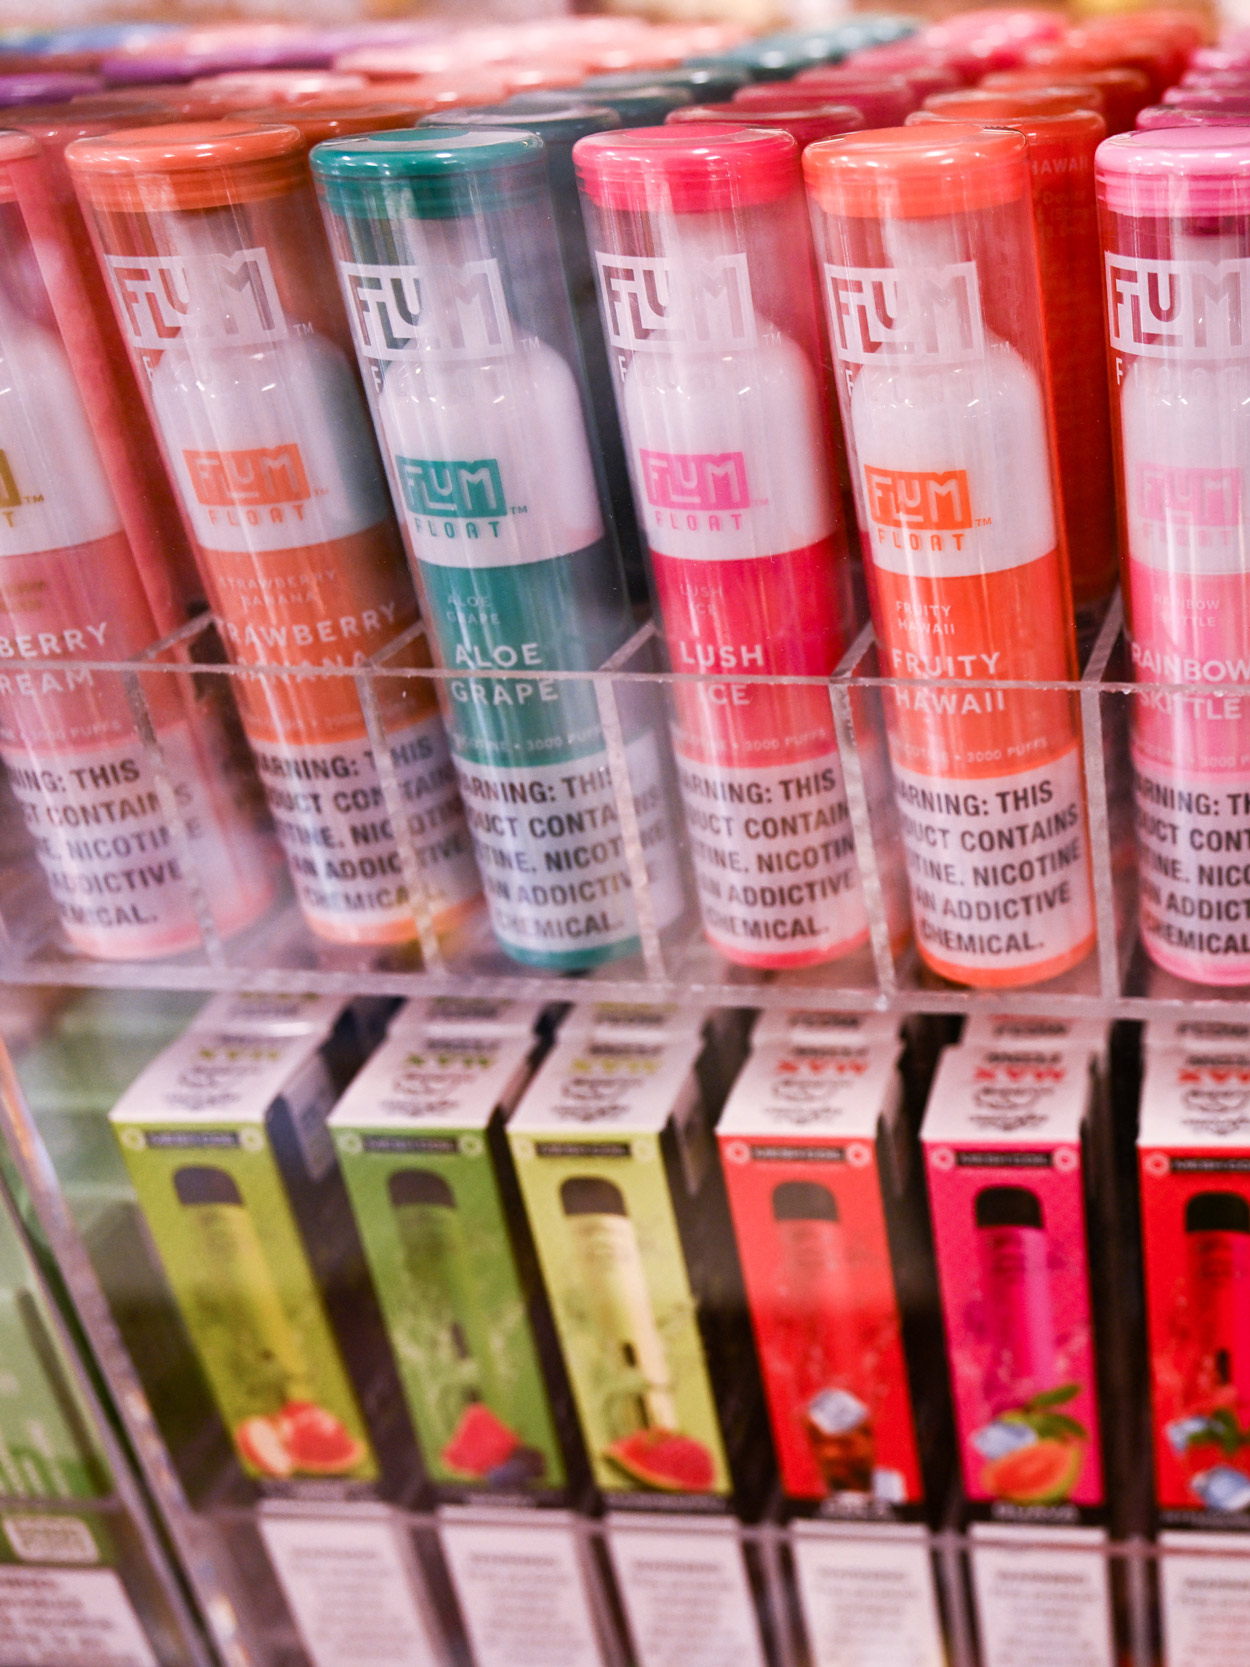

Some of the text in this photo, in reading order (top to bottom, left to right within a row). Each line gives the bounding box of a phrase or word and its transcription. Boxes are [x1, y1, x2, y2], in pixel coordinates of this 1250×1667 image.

[1107, 261, 1246, 351] FLUM
[189, 448, 308, 502] FLUM
[398, 459, 503, 514] FLUM
[644, 454, 744, 507] FLUM
[868, 469, 966, 526] FLUM
[209, 505, 305, 525] FLOAT
[413, 520, 500, 539] FLOAT
[655, 511, 742, 532] FLOAT
[879, 527, 964, 552] FLOAT
[896, 600, 952, 618] FRUITY
[899, 620, 955, 636] HAWAII
[455, 642, 544, 669] ALOE
[680, 640, 766, 669] LUSH
[891, 648, 1001, 679] FRUITY
[451, 679, 560, 707] GRAPE
[895, 689, 1006, 716] HAWAII
[1007, 736, 1048, 760] PUFFS
[69, 758, 141, 792] THIS
[779, 768, 837, 802] THIS
[996, 779, 1054, 815] THIS
[960, 803, 1079, 852] CONTAINS
[756, 836, 857, 875] NICOTIN
[972, 839, 1082, 887] NICOTINE
[942, 881, 1071, 921] ADDICTIVE
